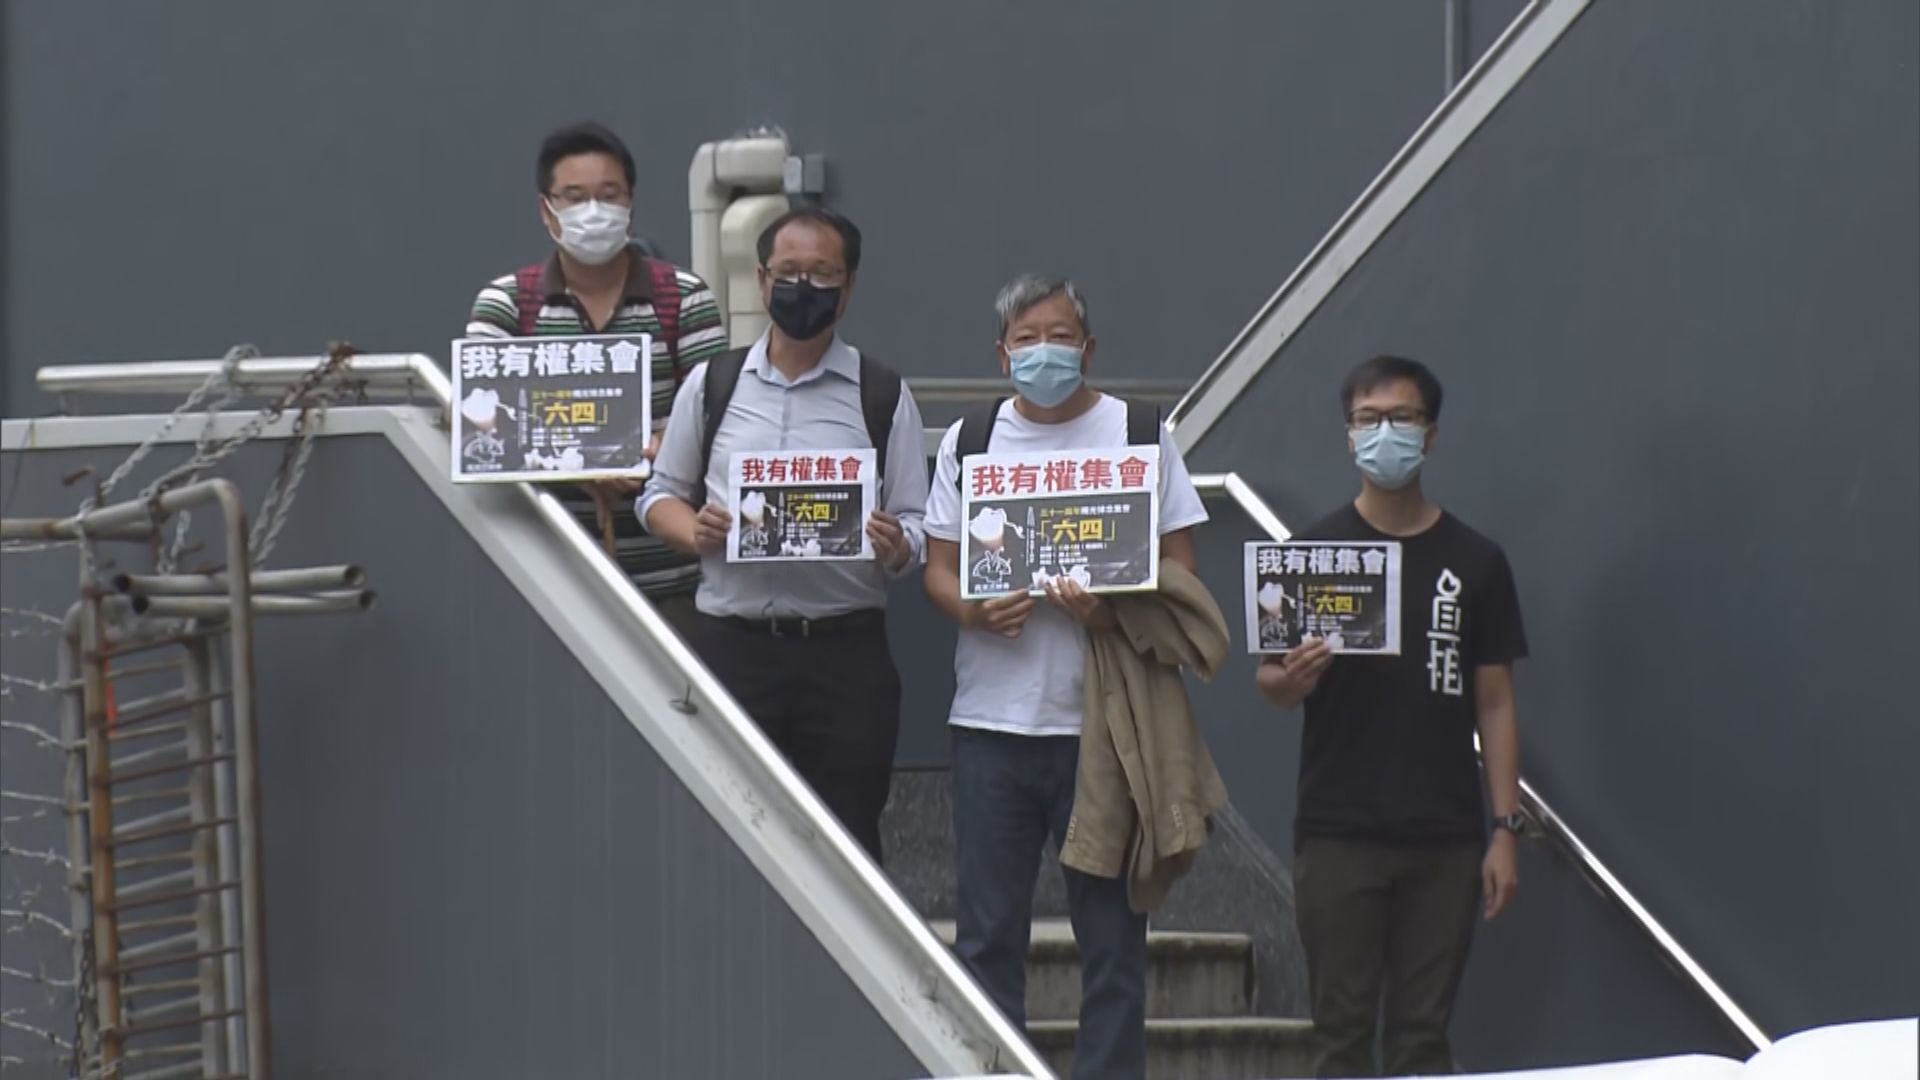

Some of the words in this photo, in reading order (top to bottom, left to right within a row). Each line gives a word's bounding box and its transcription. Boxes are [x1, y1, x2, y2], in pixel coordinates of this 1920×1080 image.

[462, 340, 641, 379] 我有權集會
[742, 456, 863, 483] 我有權集會
[972, 456, 1150, 496] 我有權集會
[1041, 518, 1116, 542] 「六四」
[1258, 548, 1386, 575] 我有權集會
